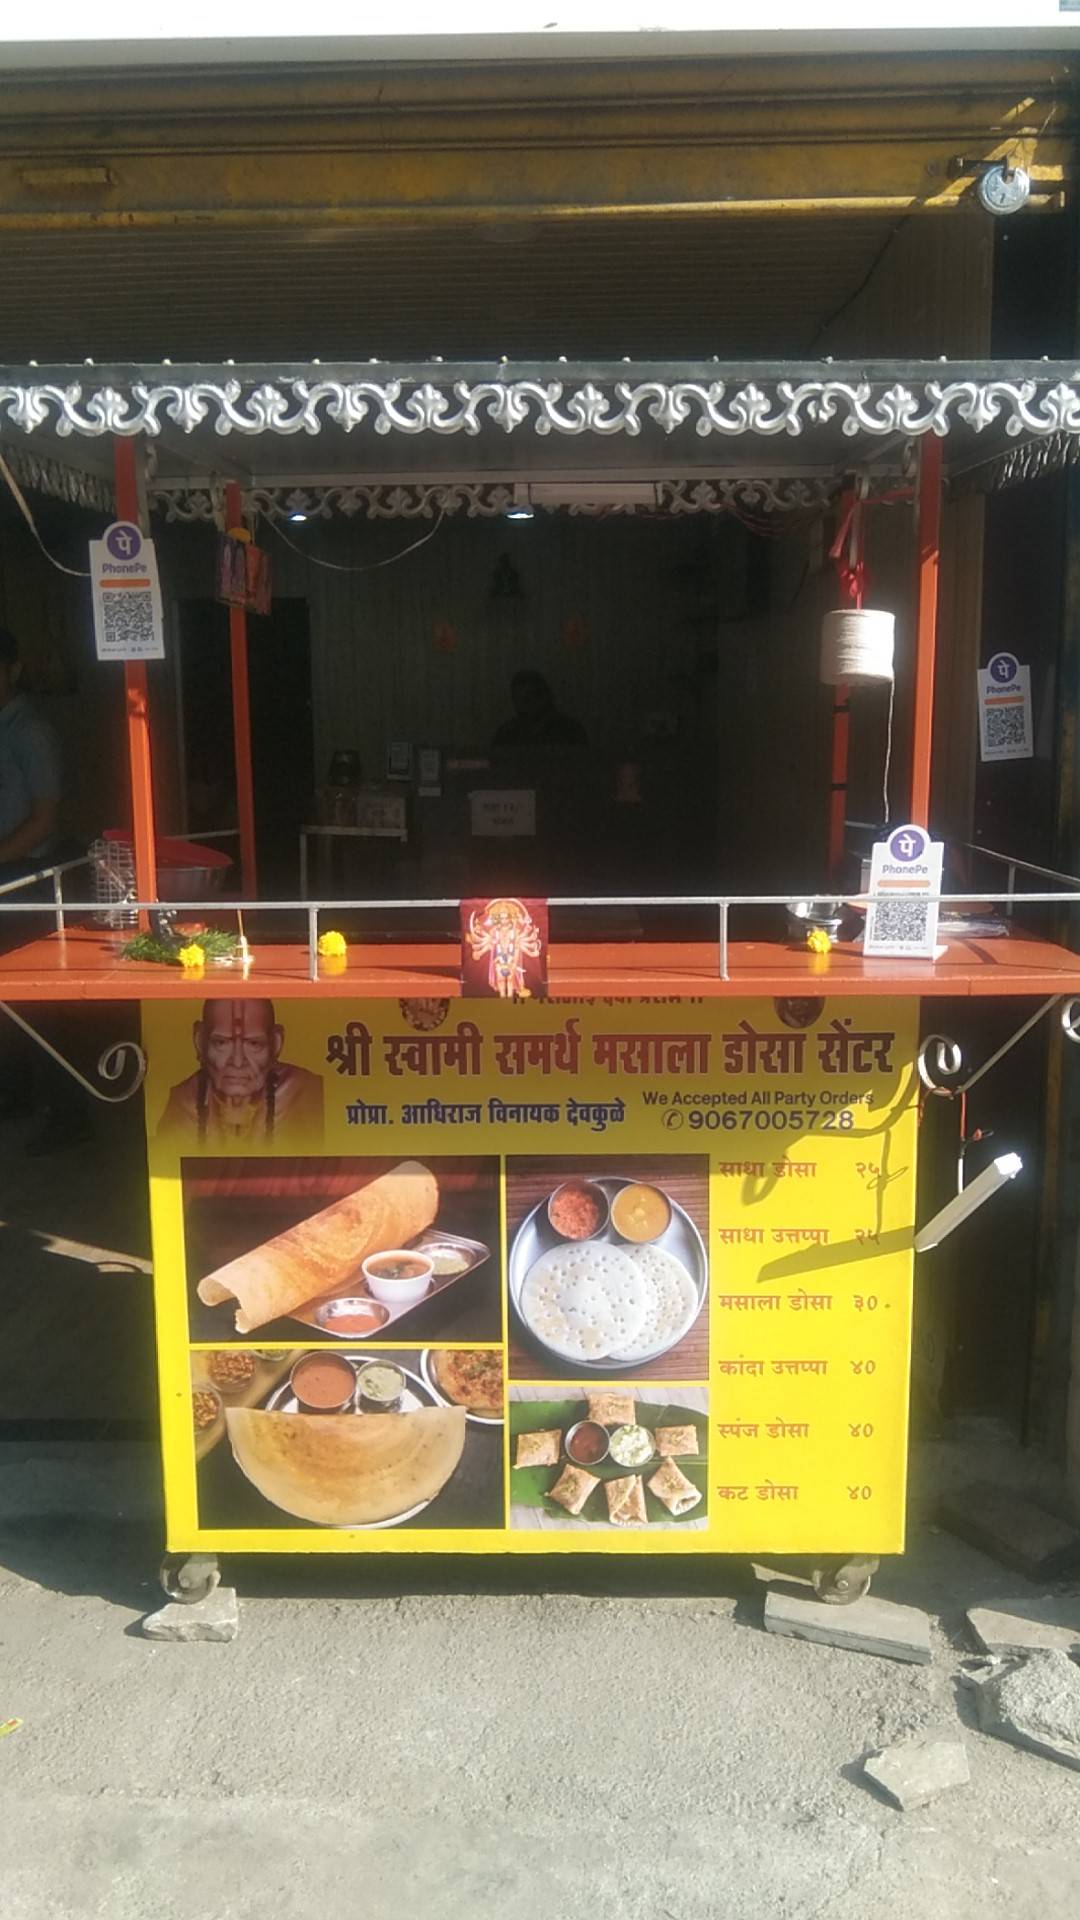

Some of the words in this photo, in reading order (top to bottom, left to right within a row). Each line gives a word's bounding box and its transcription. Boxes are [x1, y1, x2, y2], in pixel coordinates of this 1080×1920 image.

[115, 530, 133, 555] पे
[101, 562, 147, 574] PhonePe
[986, 683, 1022, 695] PhonePe
[898, 834, 917, 858] पे
[881, 864, 929, 875] PhonePe
[326, 1021, 373, 1076] श्री
[383, 1021, 483, 1076] स्वामी
[494, 1018, 582, 1075] समर्थ
[593, 1033, 712, 1075] मसाला
[722, 1019, 807, 1074] डोसा
[817, 1017, 896, 1074] सेंटर
[642, 1091, 669, 1105] We
[671, 1091, 748, 1108] Accepted
[751, 1090, 771, 1105] All
[774, 1091, 816, 1108] Party
[819, 1090, 874, 1106] Orders
[345, 1099, 395, 1125] प्रोप्रा.
[401, 1098, 483, 1125] आधिराज
[487, 1097, 561, 1125] विनायक
[566, 1097, 627, 1132] देवकुळे
[688, 1109, 854, 1130] 9067005728
[718, 1161, 765, 1178] साधा
[772, 1155, 817, 1178] डोसा
[854, 1161, 881, 1178] २५
[718, 1228, 765, 1245] साधा
[854, 1228, 881, 1246] २५
[718, 1294, 781, 1311] मसाला
[787, 1288, 833, 1311] डोसा
[853, 1294, 879, 1313] ३०
[718, 1354, 765, 1378] कांदा
[849, 1359, 876, 1376] ४०
[717, 1417, 759, 1439] स्पंज
[765, 1417, 810, 1439] डोसा
[848, 1423, 875, 1439] ४०
[716, 1485, 750, 1501] कट
[755, 1479, 799, 1501] डोसा
[846, 1485, 873, 1501] ४०
